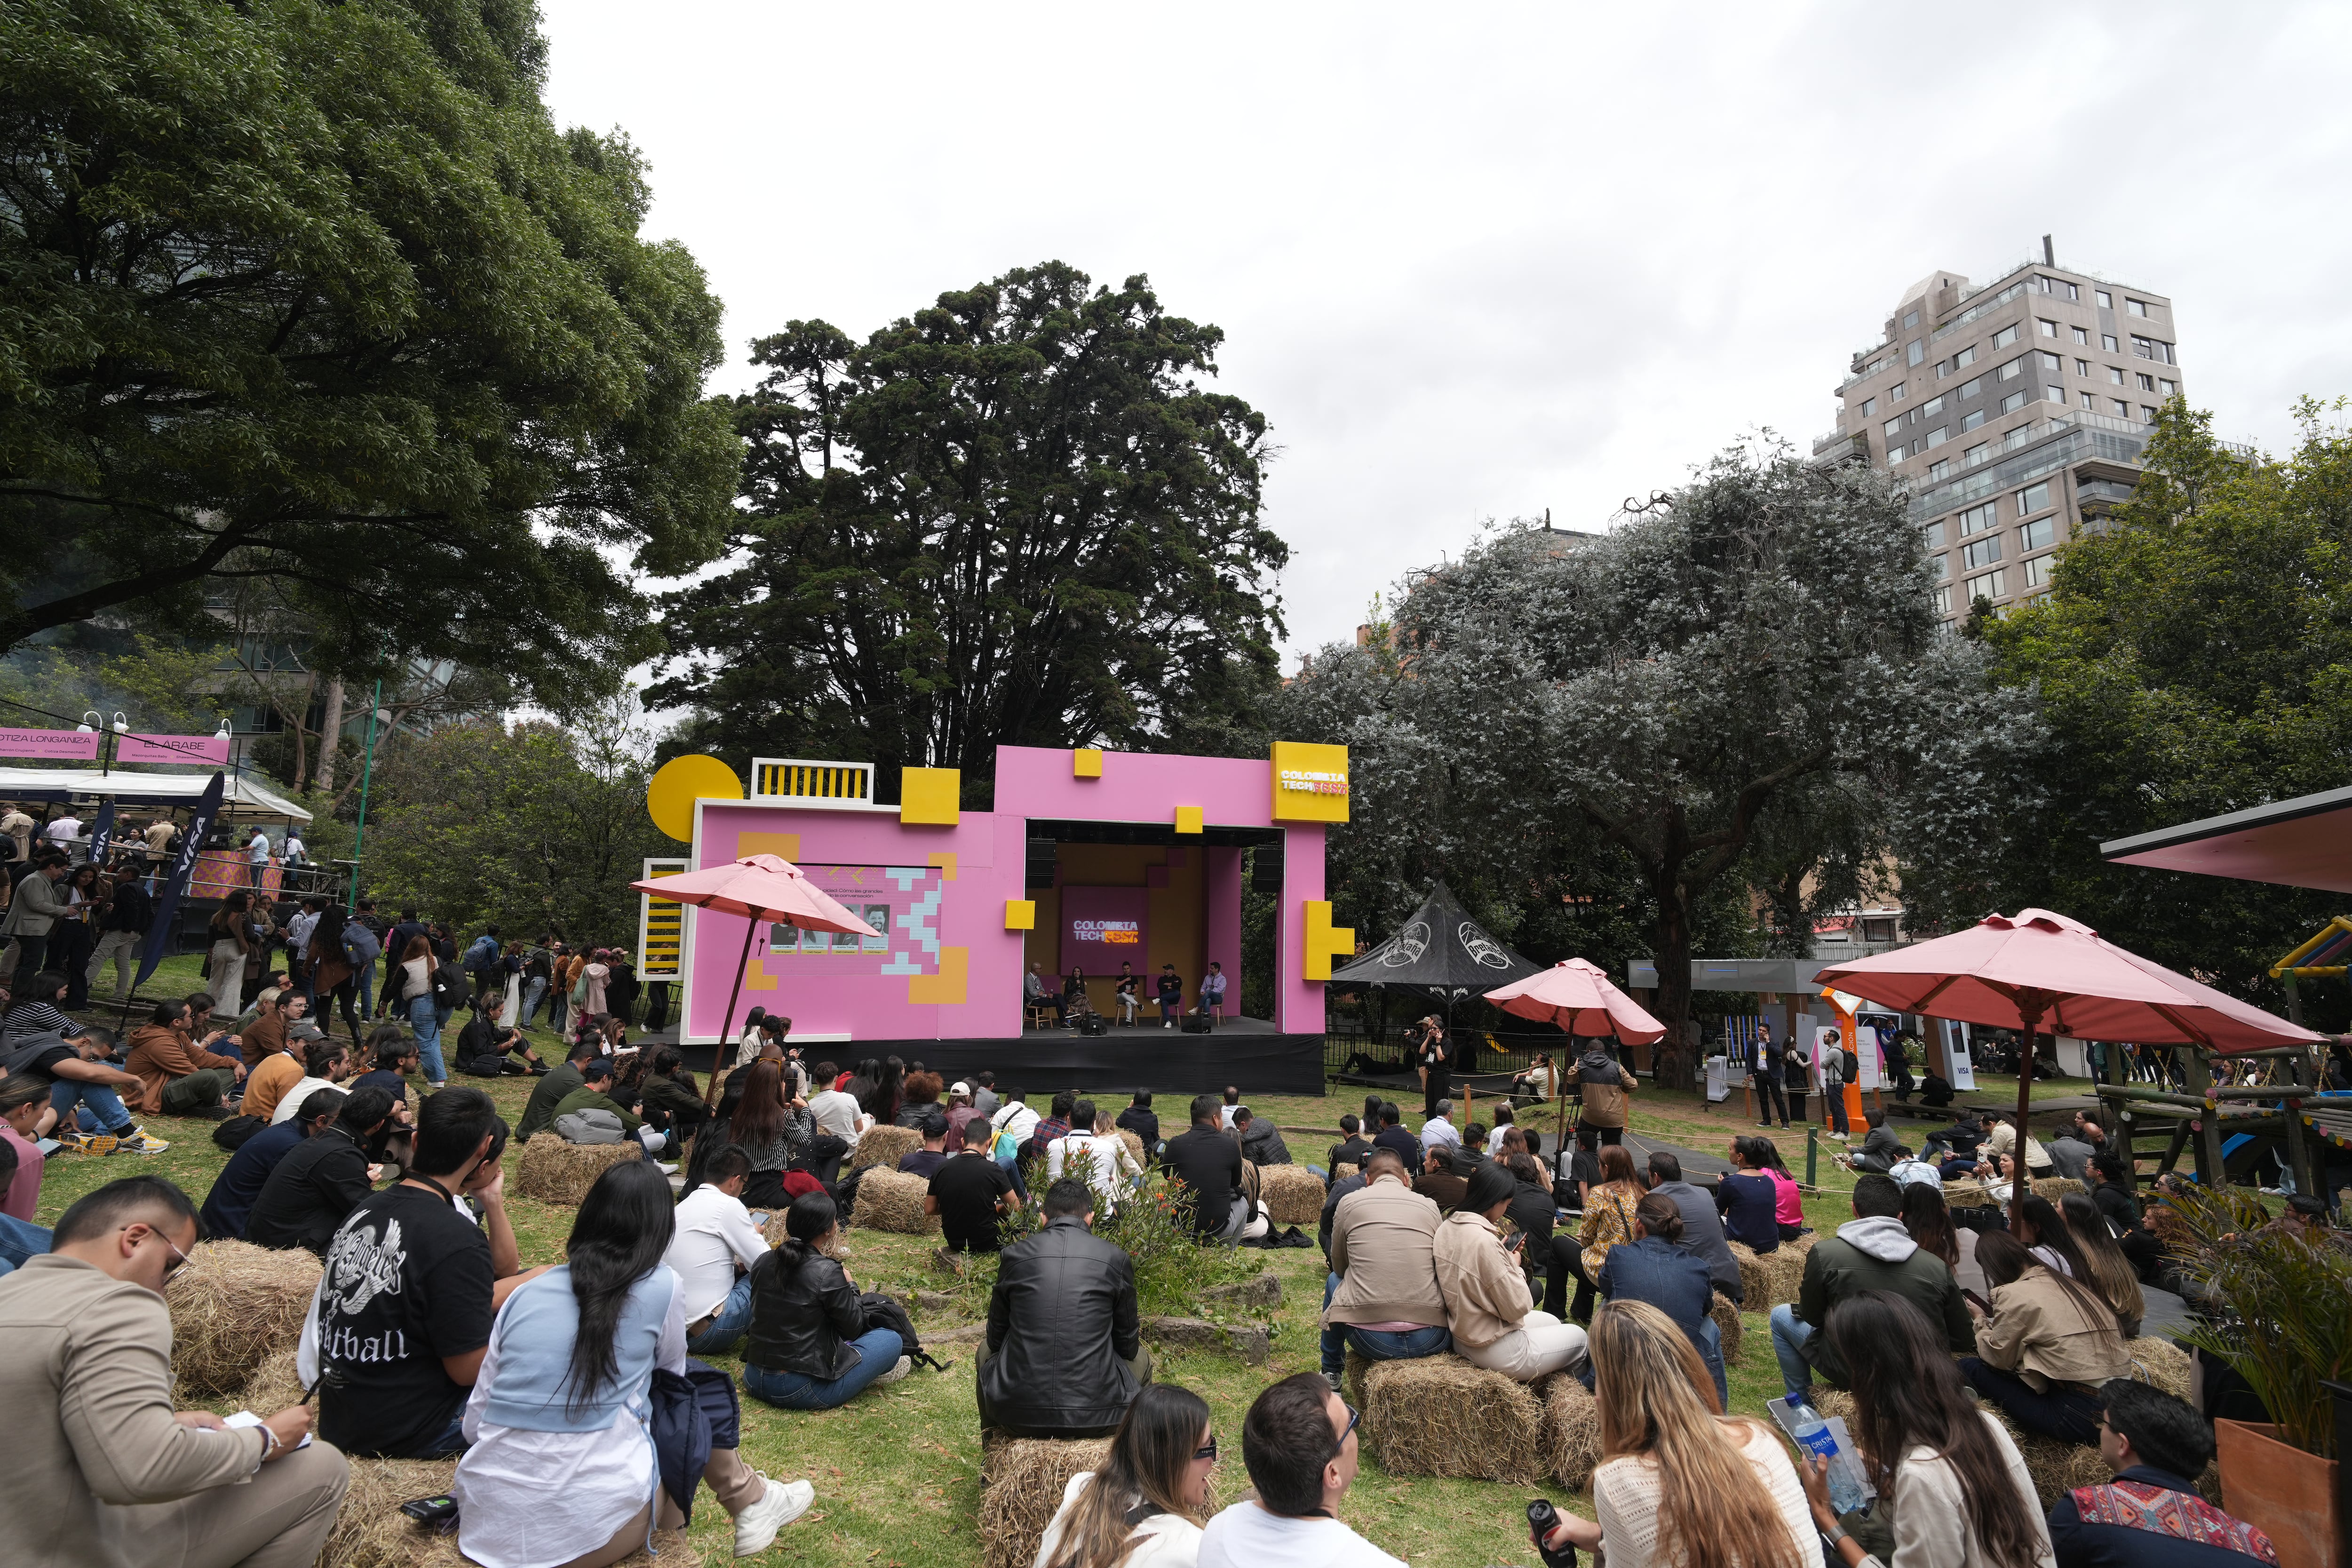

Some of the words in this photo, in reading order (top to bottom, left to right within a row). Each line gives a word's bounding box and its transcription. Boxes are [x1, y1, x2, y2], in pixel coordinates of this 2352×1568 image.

[30, 735, 91, 744] LONGANIZA
[143, 740, 159, 748] EL
[162, 740, 206, 750] ÁRABE
[1280, 770, 1346, 782] COLOMBIA
[1281, 780, 1348, 795] TECHFEST
[93, 827, 109, 863] VISA
[177, 817, 206, 877] VISA
[1073, 920, 1139, 931] COLOMBIA
[1073, 930, 1139, 943] TECHFEST
[1468, 942, 1506, 958] Bretaña
[1370, 980, 1385, 989] Bretaña
[1430, 986, 1446, 996] Bretaña
[1453, 987, 1468, 998] Bretaña
[1812, 1434, 1833, 1449] CRISTAL
